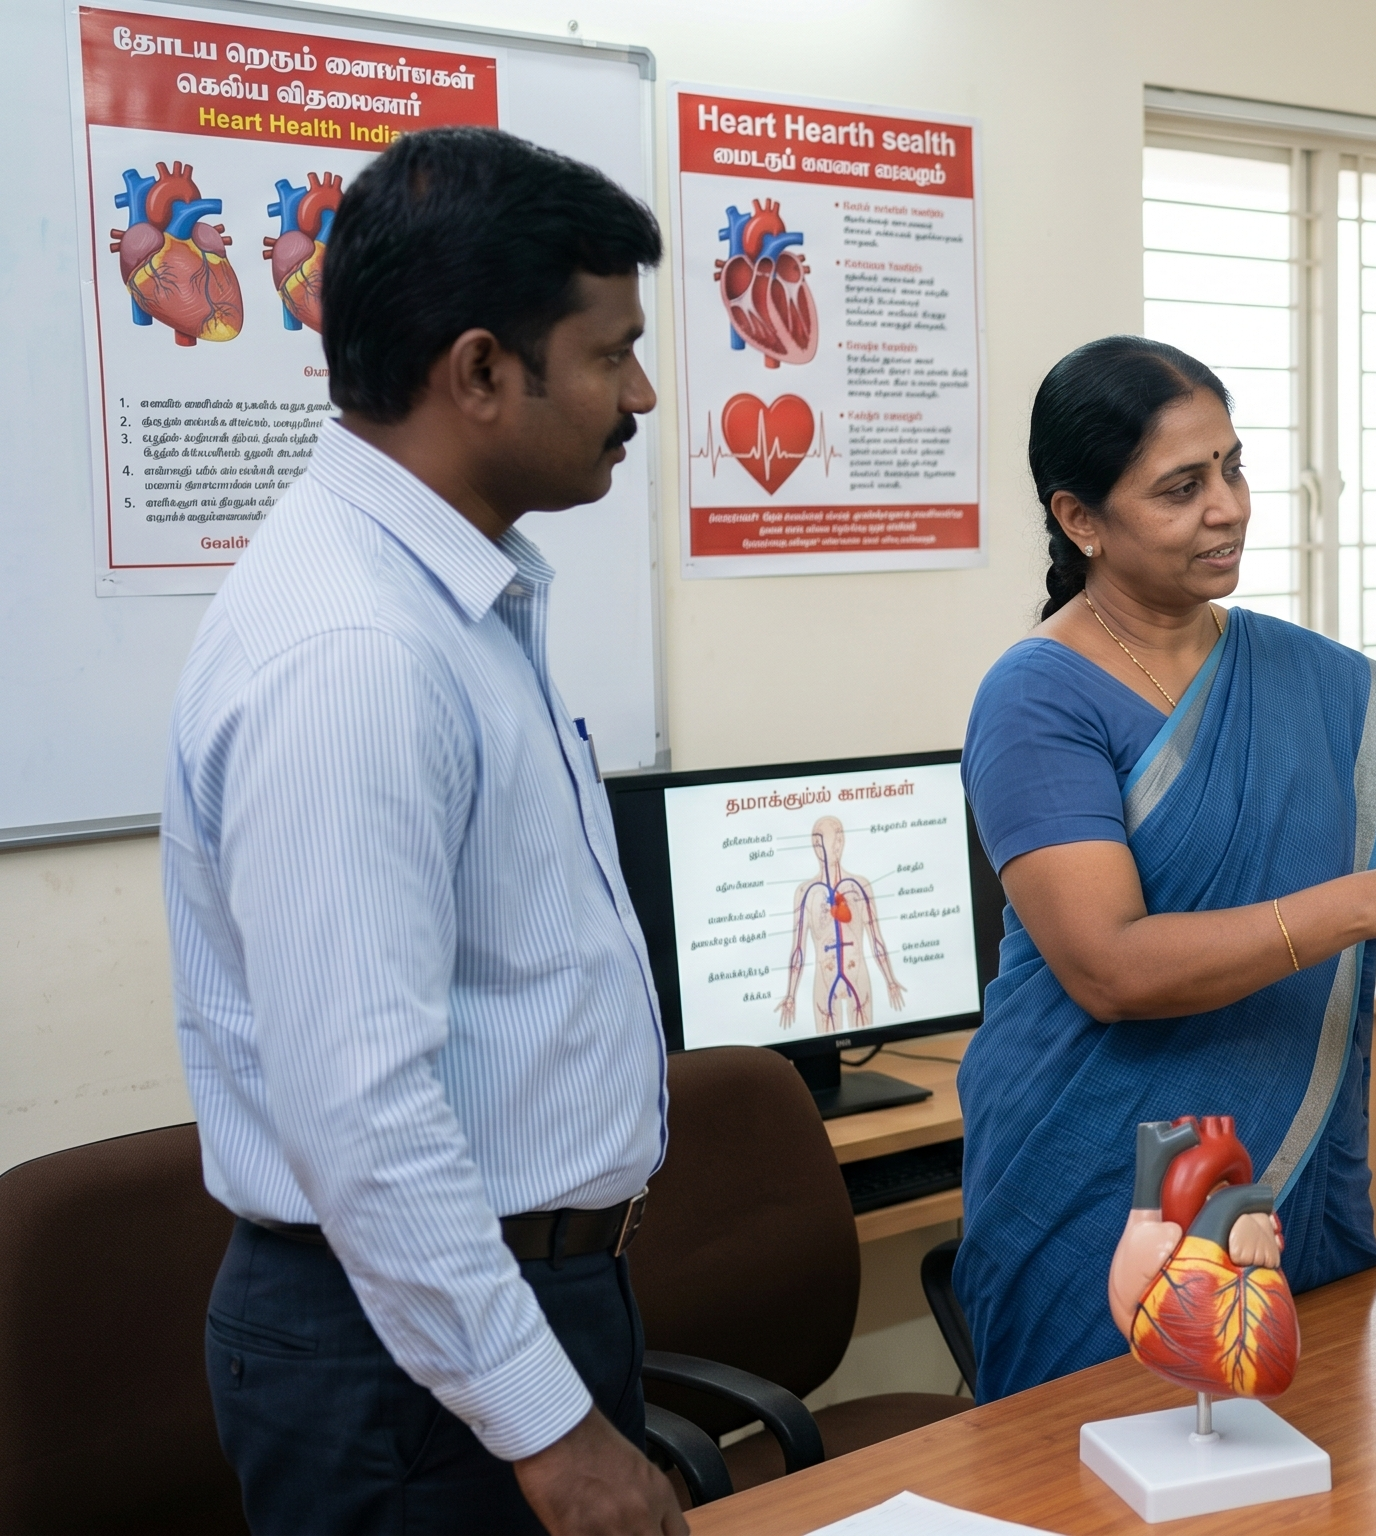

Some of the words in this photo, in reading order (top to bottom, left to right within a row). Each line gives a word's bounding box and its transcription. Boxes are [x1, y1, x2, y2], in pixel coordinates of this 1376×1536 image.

[199, 107, 262, 132] Heart
[269, 114, 342, 139] Health
[698, 104, 777, 138] Heart
[785, 114, 875, 148] Hearth
[882, 130, 956, 157] sealth
[119, 397, 130, 408] 1.
[120, 416, 131, 427] 2.
[121, 434, 132, 444] 3.
[122, 466, 134, 477] 4.
[124, 498, 135, 508] 5.
